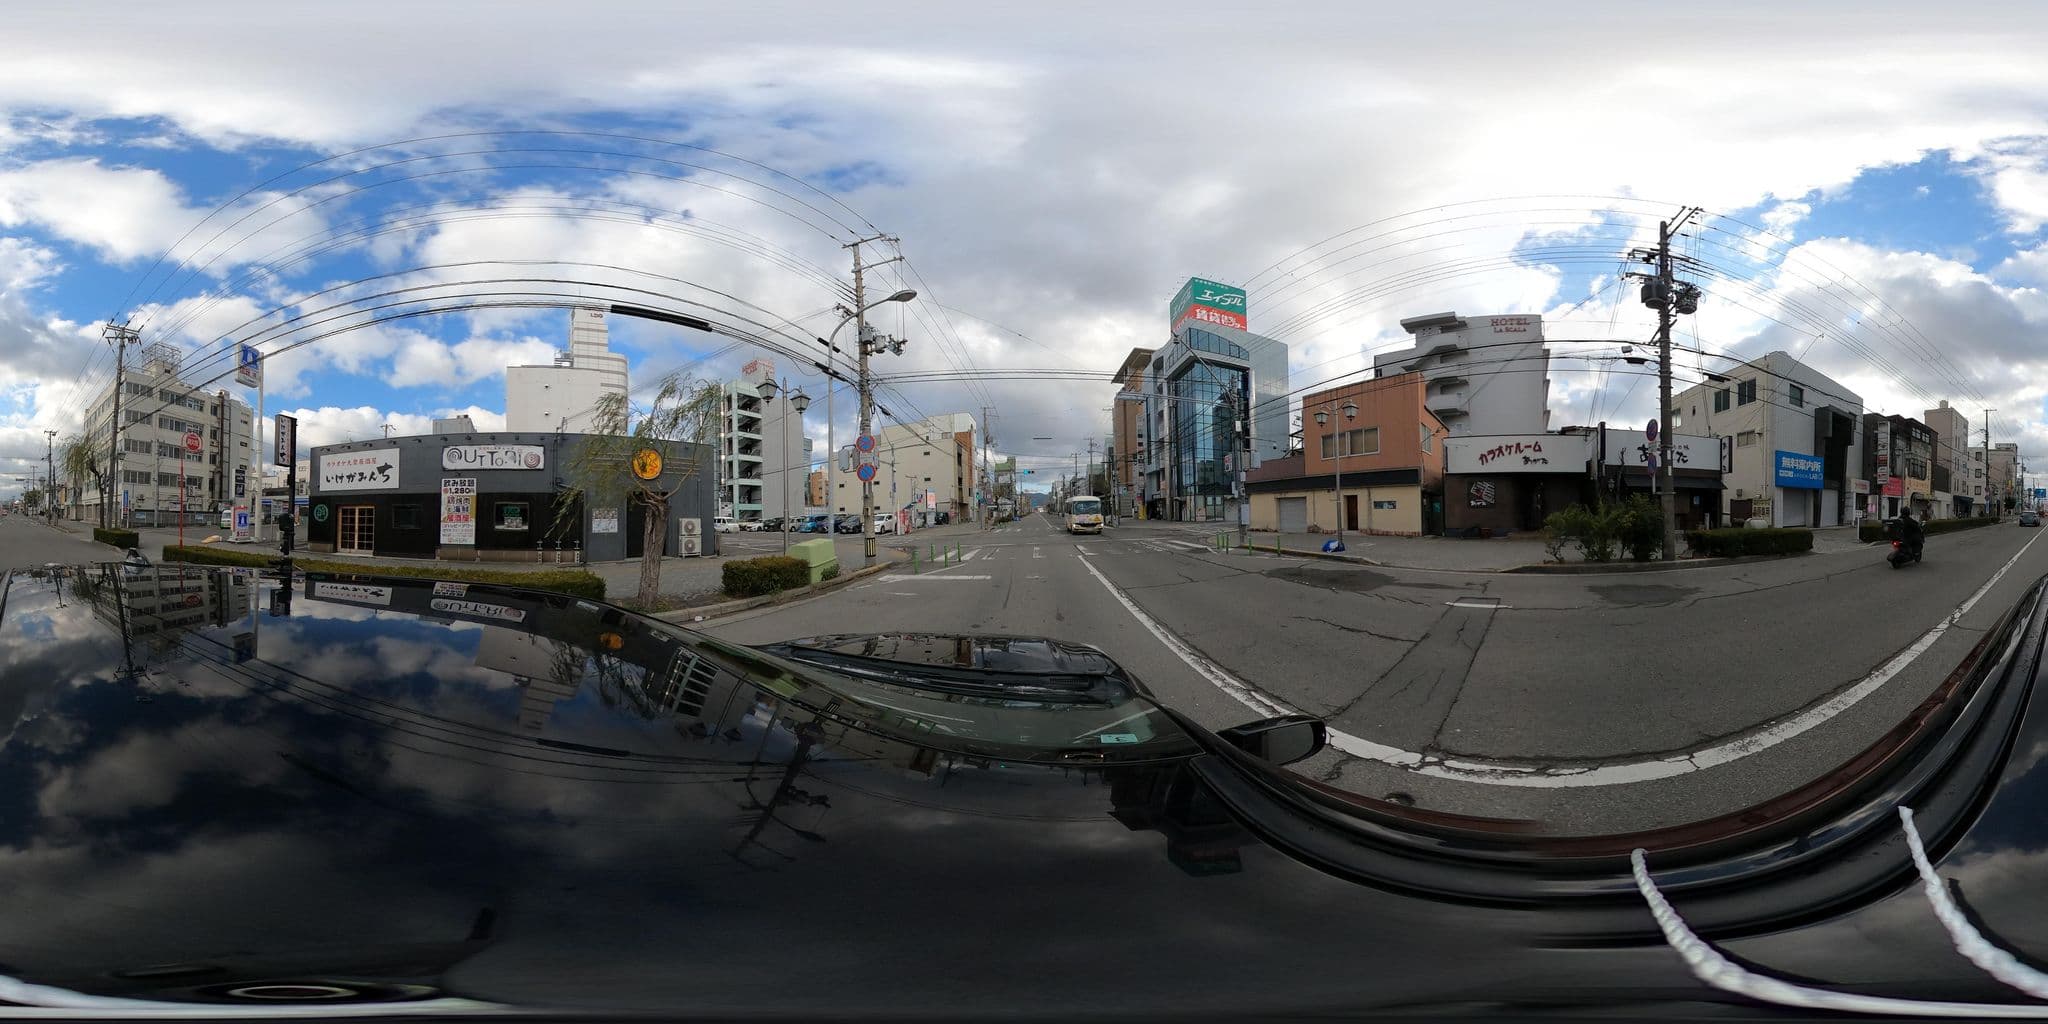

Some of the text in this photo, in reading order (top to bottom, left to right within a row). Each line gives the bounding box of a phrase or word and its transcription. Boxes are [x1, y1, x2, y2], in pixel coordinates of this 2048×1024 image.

[1479, 441, 1542, 466] カラオケルーム
